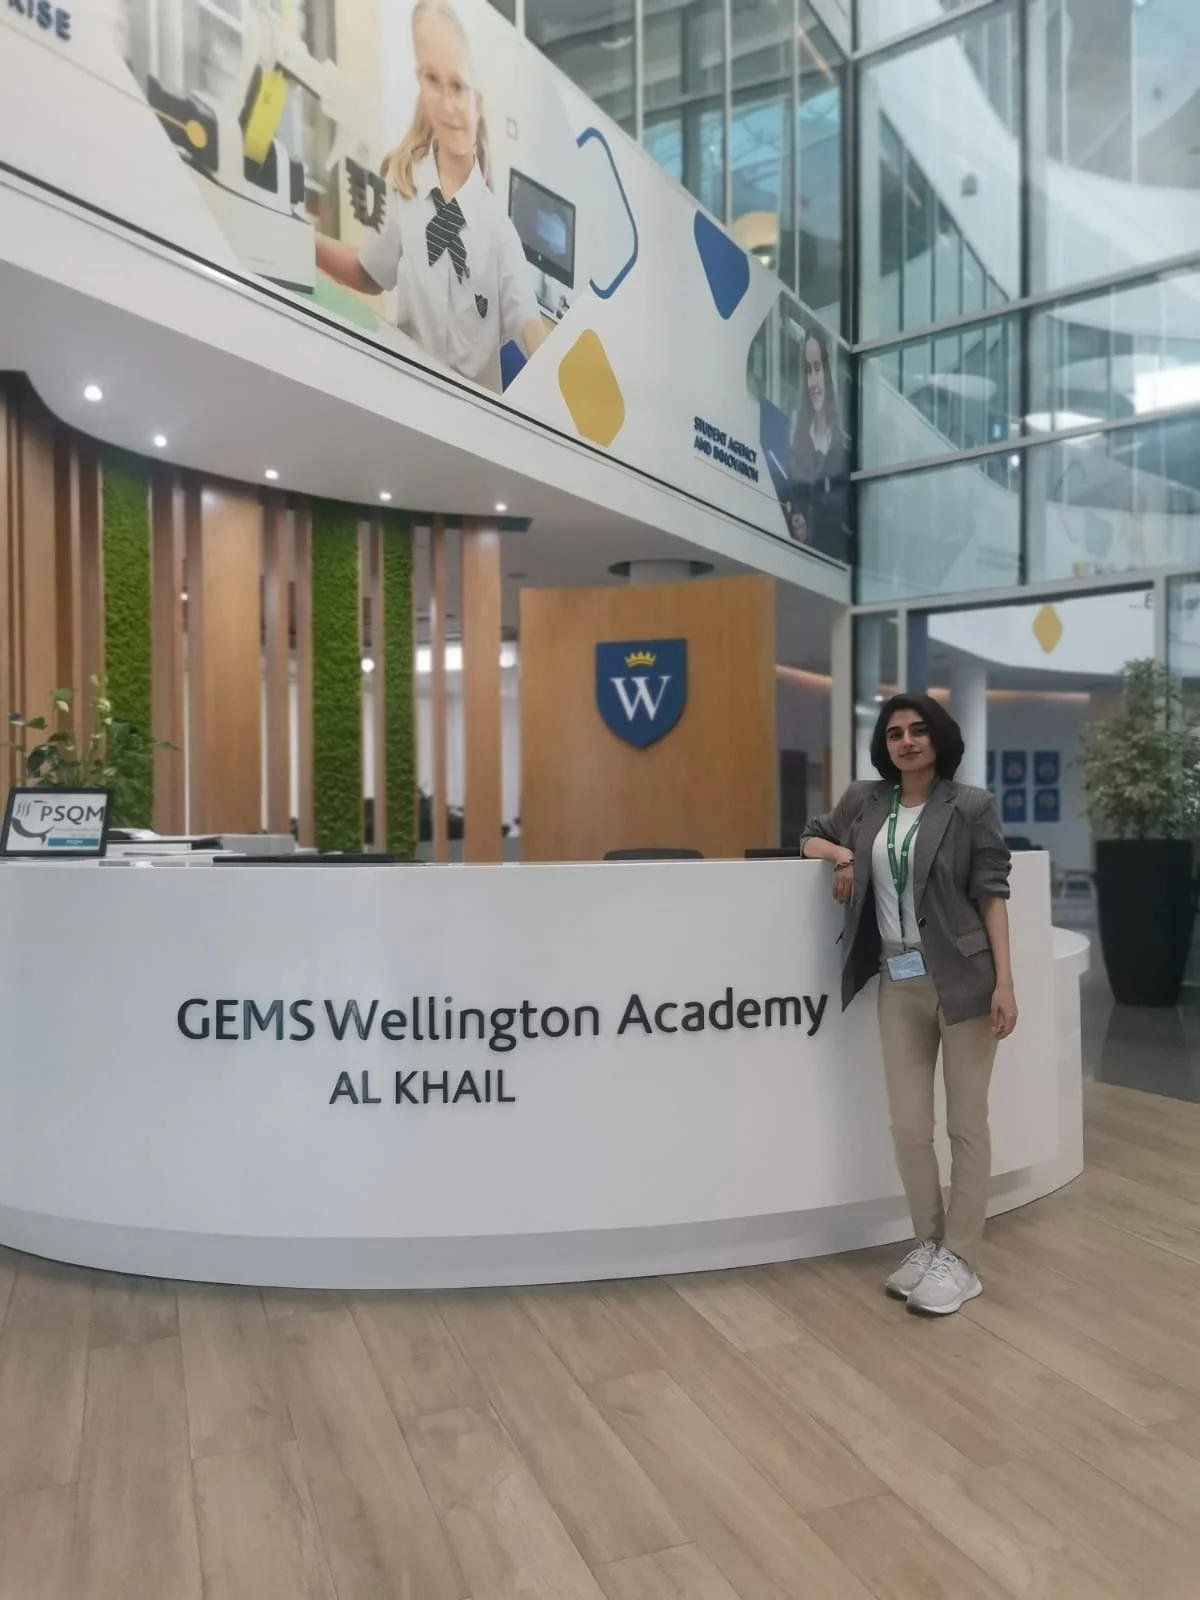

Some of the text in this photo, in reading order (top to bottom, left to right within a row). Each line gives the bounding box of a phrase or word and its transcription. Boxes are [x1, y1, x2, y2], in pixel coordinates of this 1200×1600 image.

[694, 416, 757, 464] STUDENT AGENCY
[694, 435, 758, 483] AND INNOVATION
[609, 675, 672, 721] W
[40, 805, 105, 825] PSQM
[177, 987, 828, 1052] GEMS Wellington Academy
[329, 1069, 516, 1104] AL KHAIL
